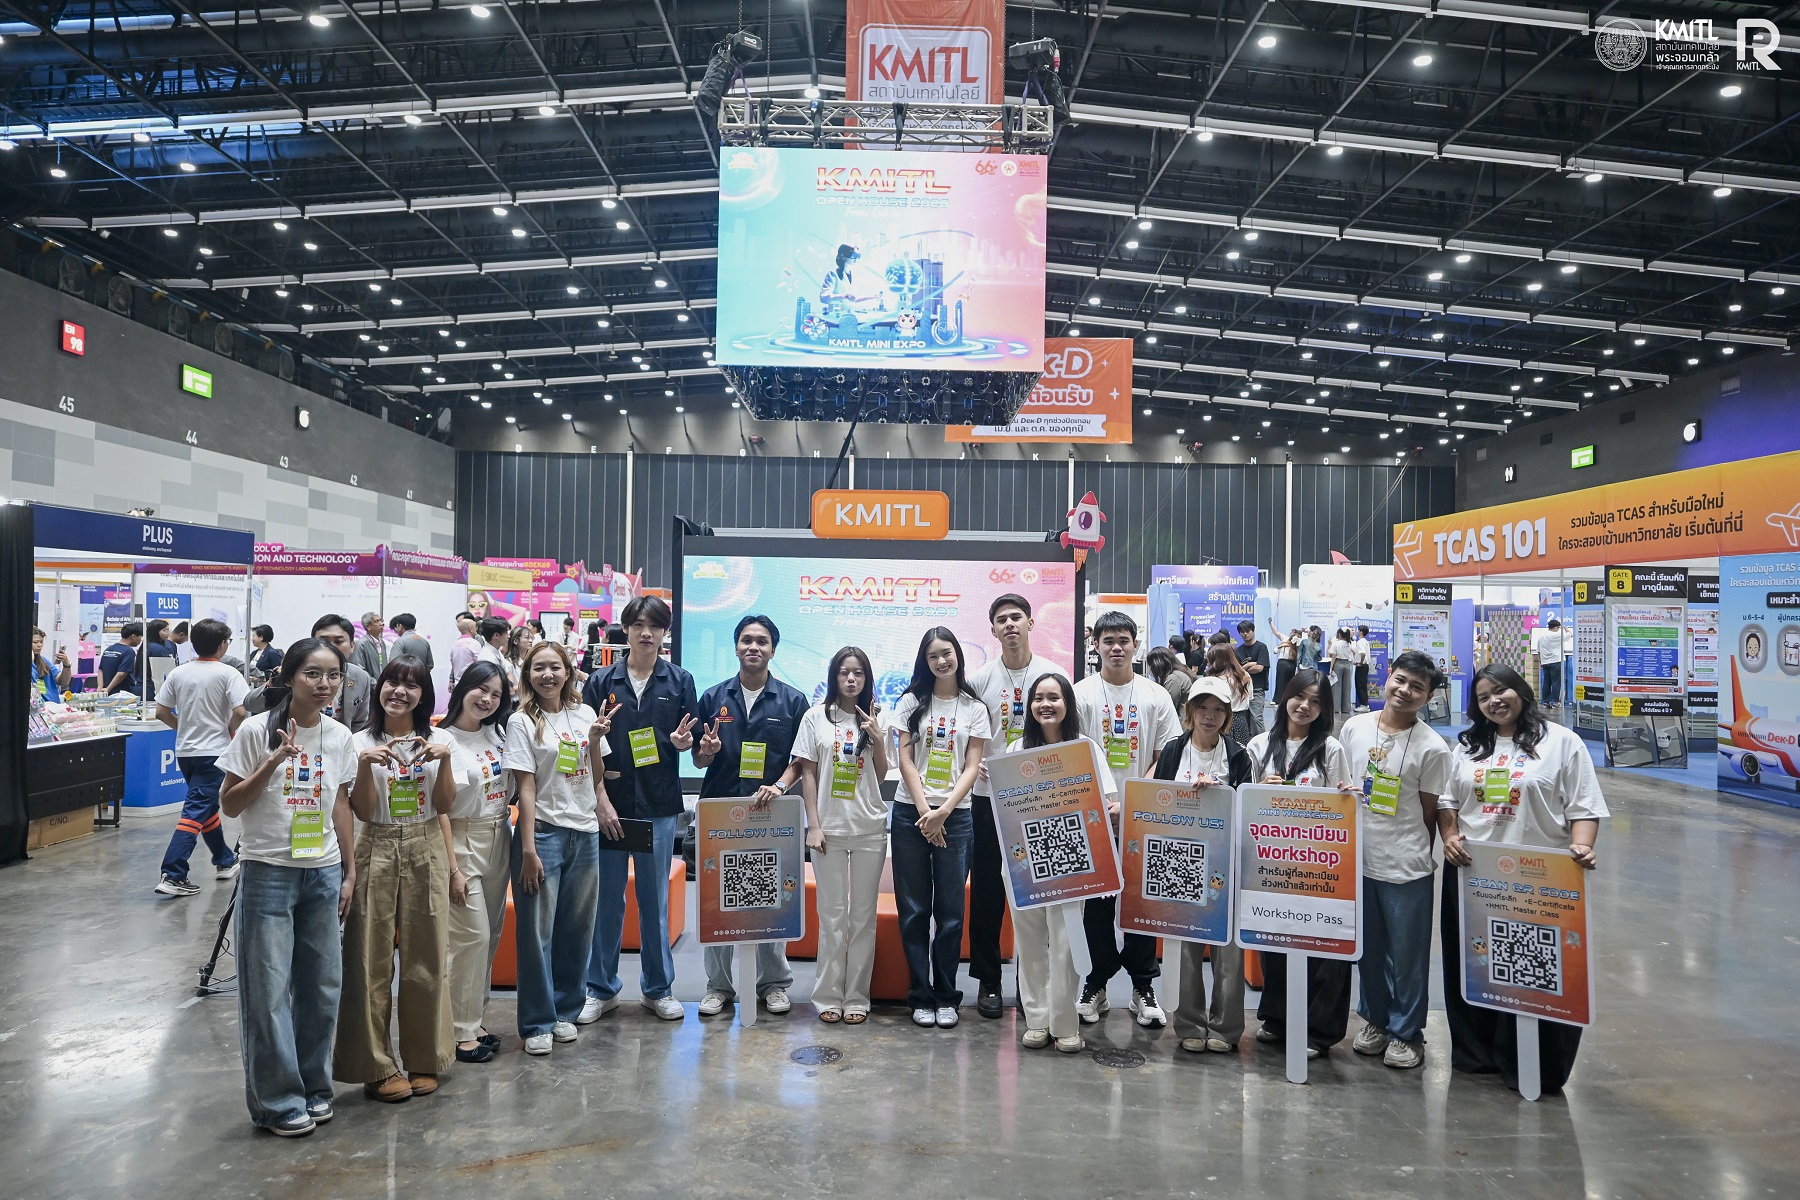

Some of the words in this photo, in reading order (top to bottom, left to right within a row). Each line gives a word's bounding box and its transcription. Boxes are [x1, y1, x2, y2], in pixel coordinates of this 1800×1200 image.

[869, 44, 979, 83] KMITL
[868, 84, 980, 100] สถาบันเทคโนโลยี
[816, 166, 952, 194] KMITL
[816, 196, 856, 205] OPEN
[858, 196, 908, 207] HOUSE
[911, 198, 949, 208] 2026
[828, 338, 864, 348] KMITL
[866, 339, 892, 348] MINI
[894, 340, 926, 349] EXPO
[58, 396, 75, 413] 45
[1049, 424, 1084, 434] ของทุกปี
[186, 430, 198, 445] 44
[280, 455, 288, 468] 43
[350, 474, 358, 486] 42
[406, 490, 413, 500] 41
[835, 502, 930, 528] KMITL
[1570, 510, 1615, 529] รวมข้อมูล
[1616, 508, 1646, 522] TCAS
[1648, 492, 1724, 518] สำหรับมือใหม่
[142, 524, 173, 545] PLUS
[1558, 520, 1682, 550] ใครจะสอบเข้ามหาวิทยาลัย
[1685, 510, 1744, 537] เริ่มต้นที่นี่
[1433, 526, 1496, 566] TCAS
[1502, 516, 1546, 560] 101
[274, 555, 292, 563] AND
[299, 555, 358, 564] TECHNOLOGY
[1635, 572, 1656, 580] คณะนี้
[1740, 563, 1774, 576] รวมข้อมูล
[1776, 564, 1796, 572] TCAS
[800, 575, 961, 603] KMITL
[1616, 581, 1625, 589] 8
[1208, 592, 1254, 601] สร้างเส้นทาง
[158, 598, 179, 609] PLUS
[799, 605, 845, 615] OPEN
[850, 606, 908, 616] HOUSE
[1767, 732, 1796, 745] Dek-D
[1038, 753, 1061, 766] KMITL
[998, 784, 1033, 800] SCAN
[1036, 780, 1056, 792] QR
[1058, 773, 1093, 788] CODE
[1051, 787, 1091, 799] E-Certificate
[1176, 789, 1200, 800] KMITL
[1041, 801, 1061, 810] Master
[1272, 796, 1331, 812] KMITL
[1482, 805, 1515, 815] KMITL
[1133, 811, 1195, 826] FOLLOW
[1199, 818, 1224, 829] US!
[1258, 808, 1280, 816] MINI
[1282, 809, 1344, 820] WORKSHOP
[50, 816, 70, 827] C/NO:
[708, 828, 767, 839] FOLLOW
[770, 827, 795, 837] US!
[1249, 822, 1348, 843] จุดลงทะเบียน
[1257, 845, 1340, 869] Workshop
[1520, 856, 1547, 869] KMITL
[1258, 866, 1339, 882] สำหรับผู้ที่ลงทะเบียน
[1262, 879, 1335, 893] ล่วงหน้าแล้วเท่านั้น
[1468, 876, 1508, 891] SCAN
[1512, 883, 1535, 895] QR
[1538, 887, 1580, 900] CODE
[1489, 902, 1510, 912] KMITL
[1513, 906, 1537, 915] Master
[1540, 910, 1560, 919] Class
[1528, 898, 1575, 911] E-Certificate
[1252, 906, 1312, 923] Workshop
[1316, 912, 1343, 925] Pass
